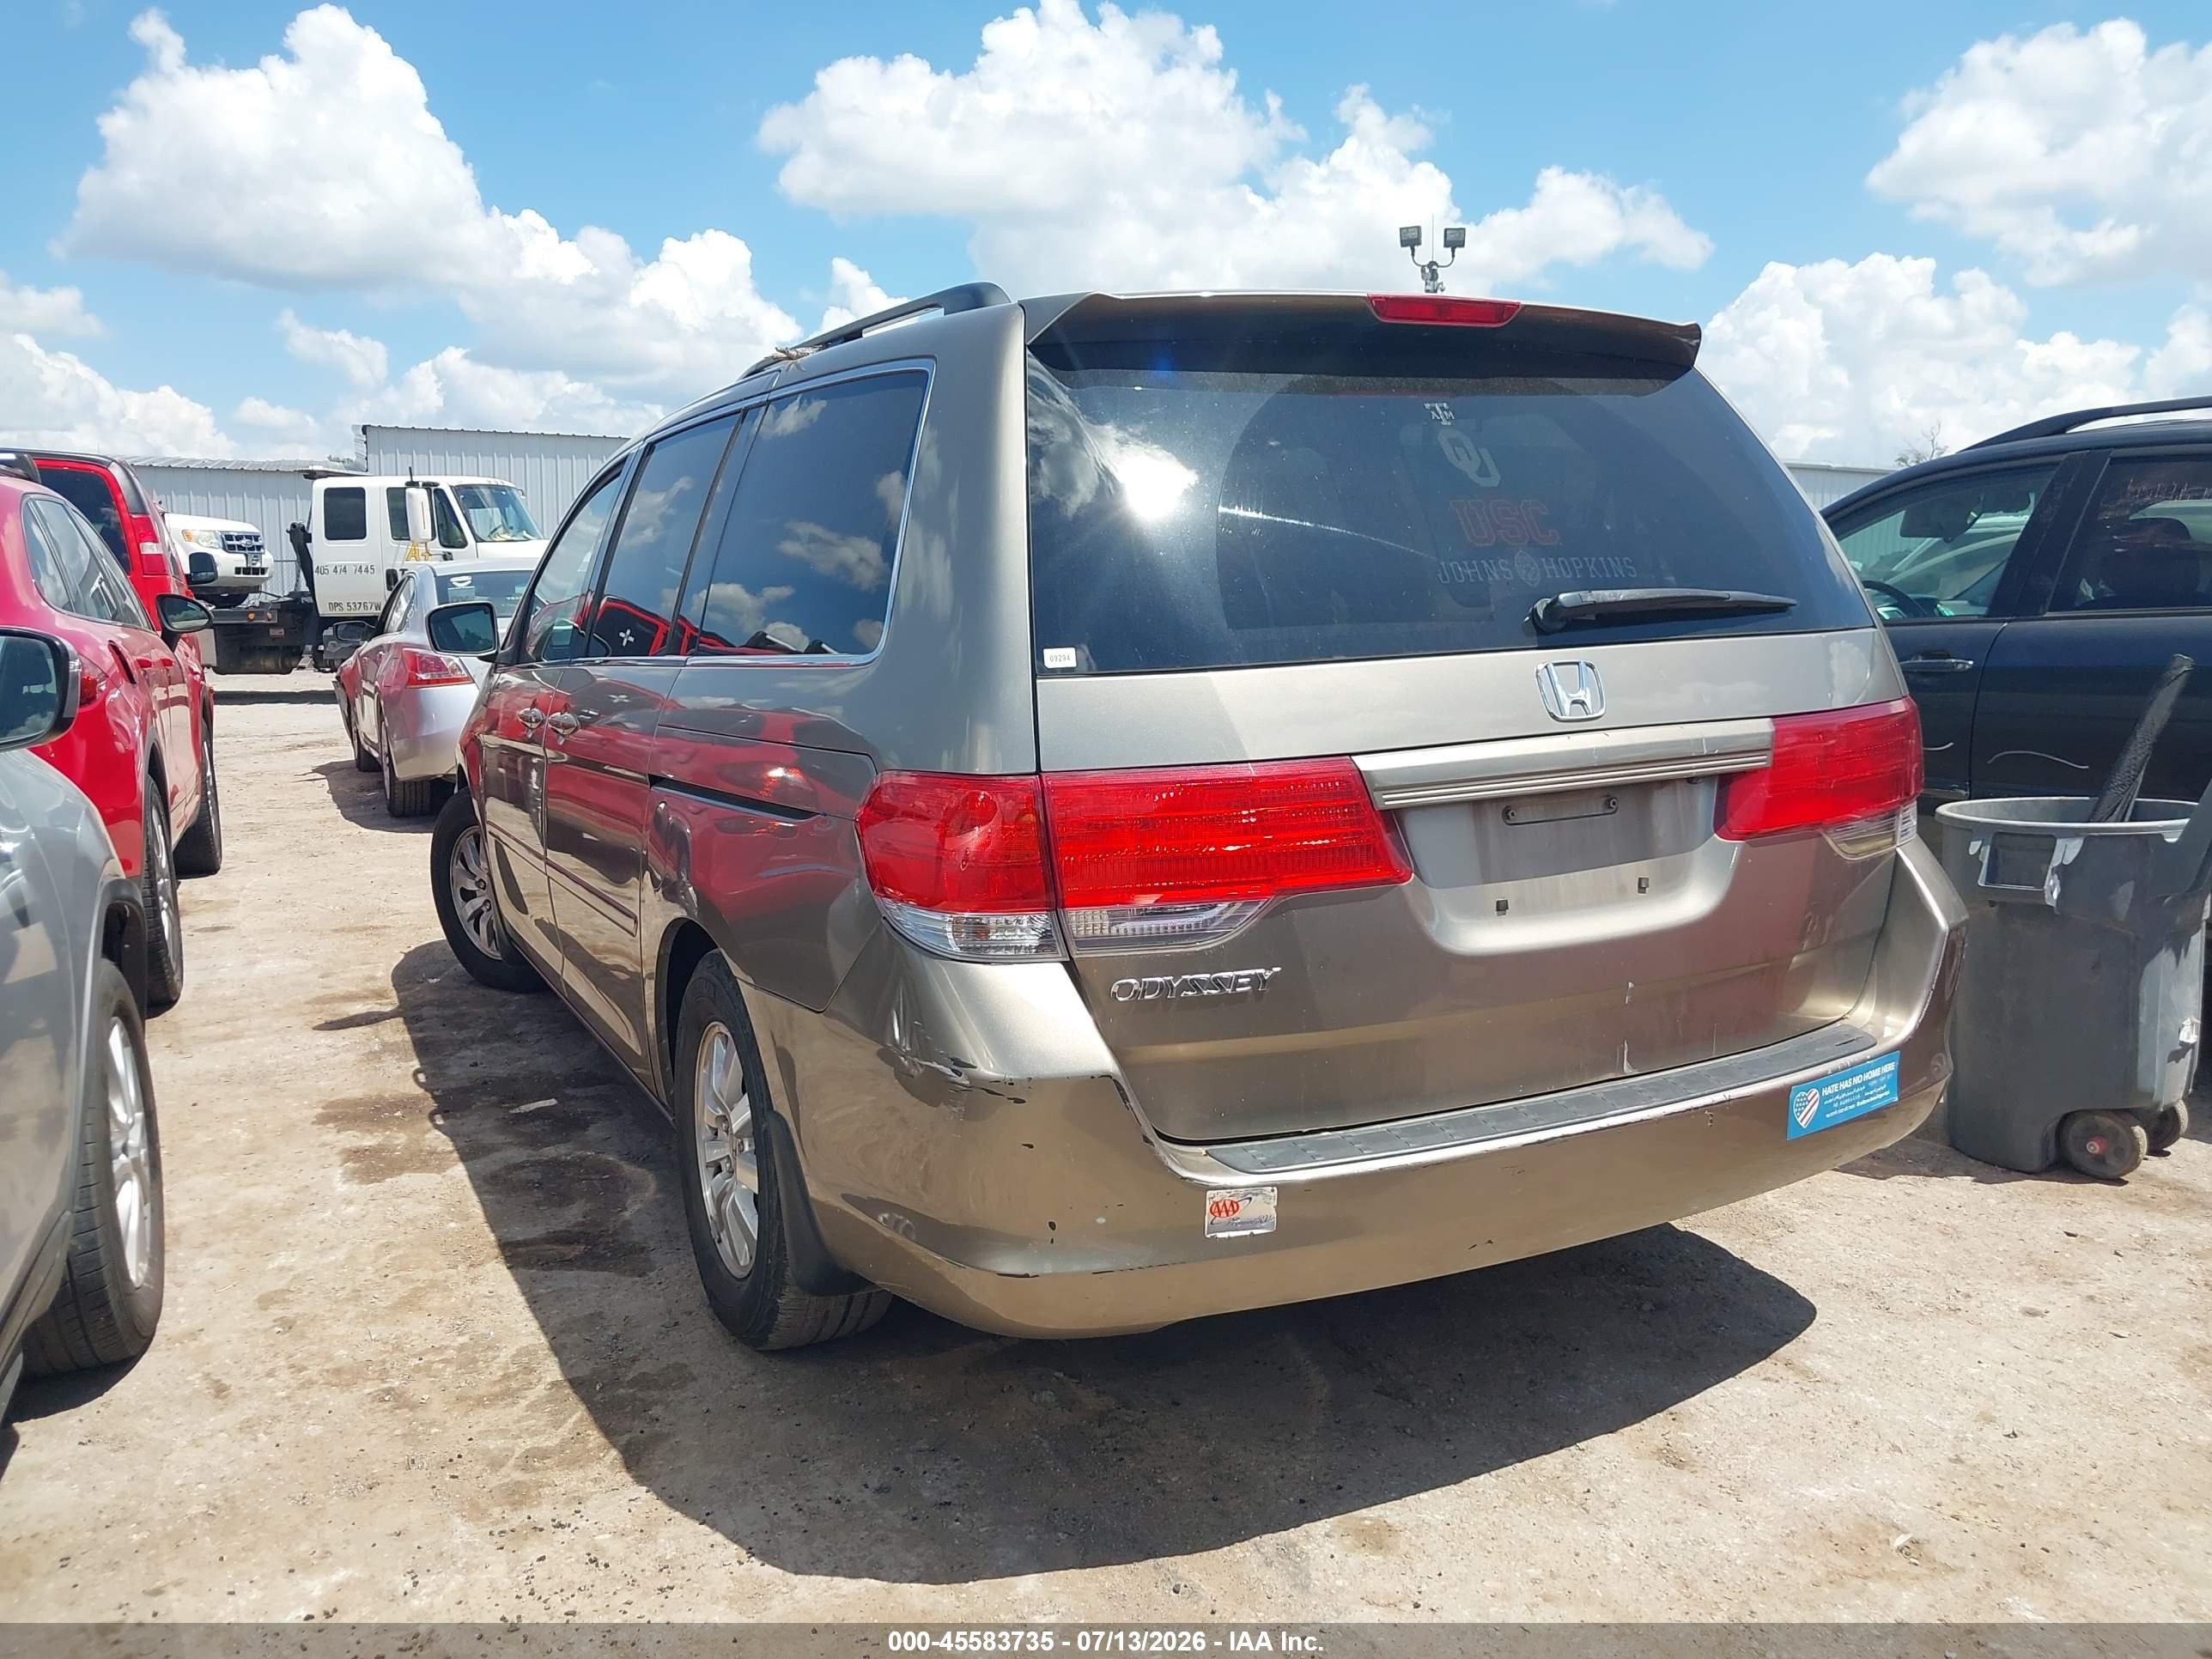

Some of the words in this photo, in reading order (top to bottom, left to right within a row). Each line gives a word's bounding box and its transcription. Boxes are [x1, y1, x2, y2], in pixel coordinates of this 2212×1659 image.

[1449, 498, 1559, 547] USC
[314, 564, 330, 575] 405
[332, 564, 348, 575] 474
[353, 564, 375, 575] 7445
[1437, 559, 1513, 584] JOHNS
[1540, 556, 1637, 578] HOPKINS
[328, 602, 344, 612] DPS
[346, 601, 382, 611] 53767W
[1110, 967, 1282, 1001] ODYSSEY
[1821, 1083, 1839, 1097] HATE
[1839, 1078, 1853, 1091] HAS
[1852, 1074, 1863, 1085] NO
[1863, 1067, 1881, 1081] HOME
[1881, 1061, 1896, 1073] HERE
[1211, 1200, 1239, 1218] AAA
